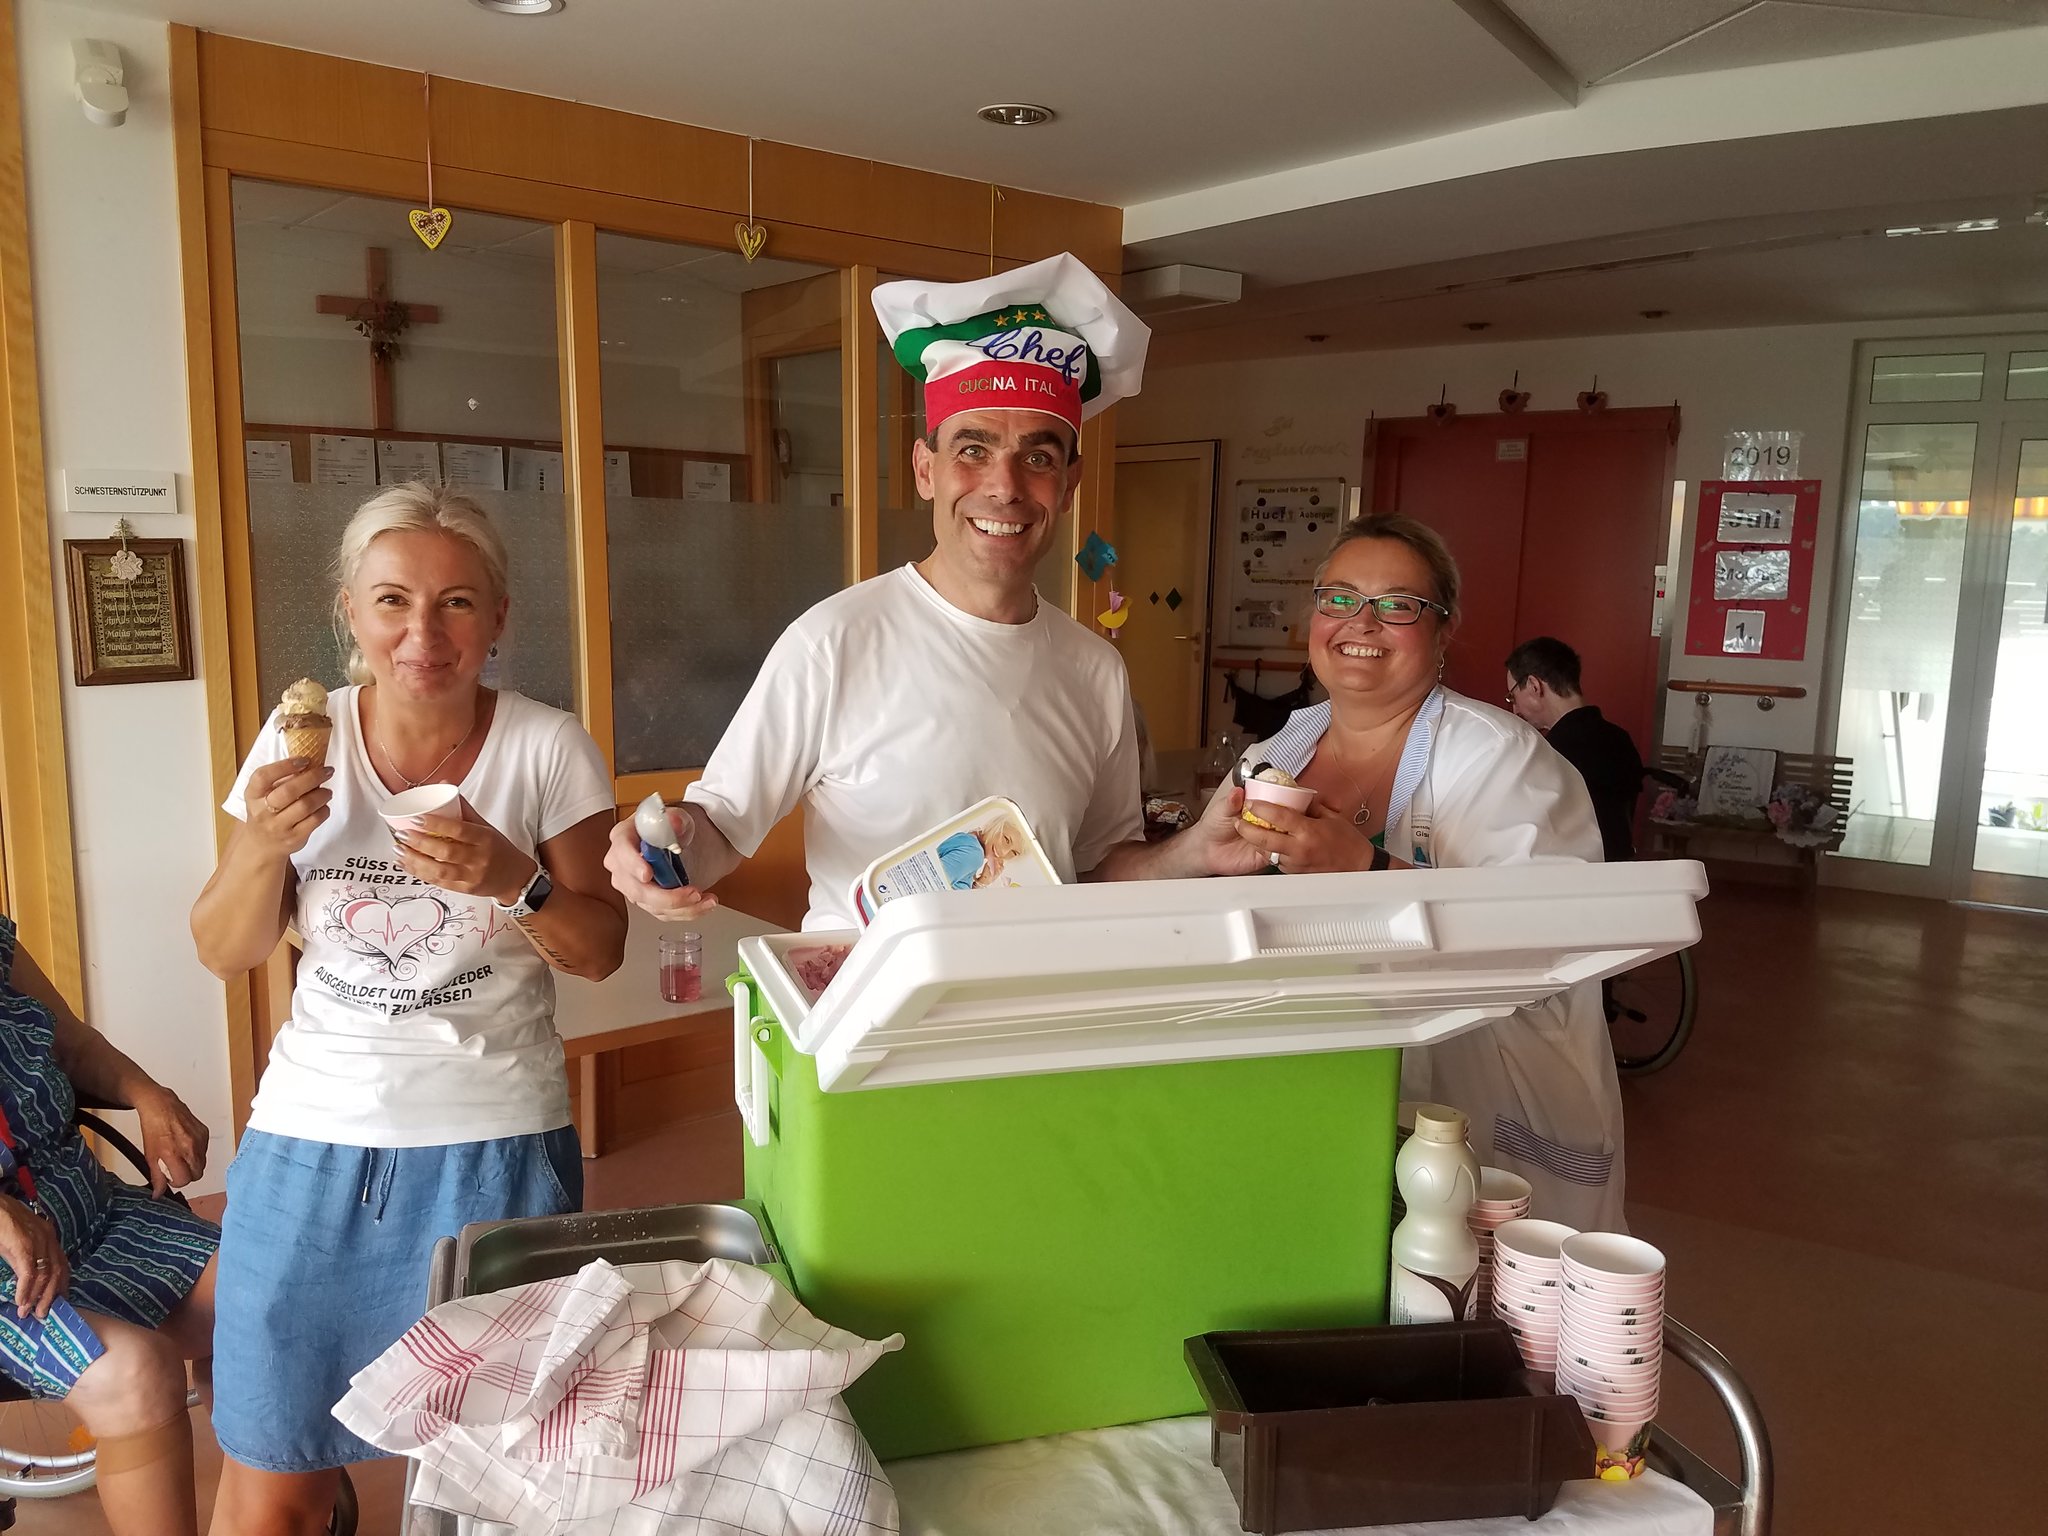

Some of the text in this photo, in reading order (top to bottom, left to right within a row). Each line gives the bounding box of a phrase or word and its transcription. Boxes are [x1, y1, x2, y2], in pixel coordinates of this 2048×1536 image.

[965, 328, 1085, 385] Chef
[959, 375, 1057, 398] CUCINA ITAL
[1731, 446, 1791, 467] 2019
[74, 485, 168, 497] SCHWESTERNSTÜTZPUNKT
[344, 855, 389, 872] SÜSS
[318, 868, 354, 881] DEIN
[358, 874, 407, 886] HERZ
[313, 965, 388, 999] AUSGEBILDET
[389, 987, 416, 1001] UM
[390, 1002, 416, 1017] ZU
